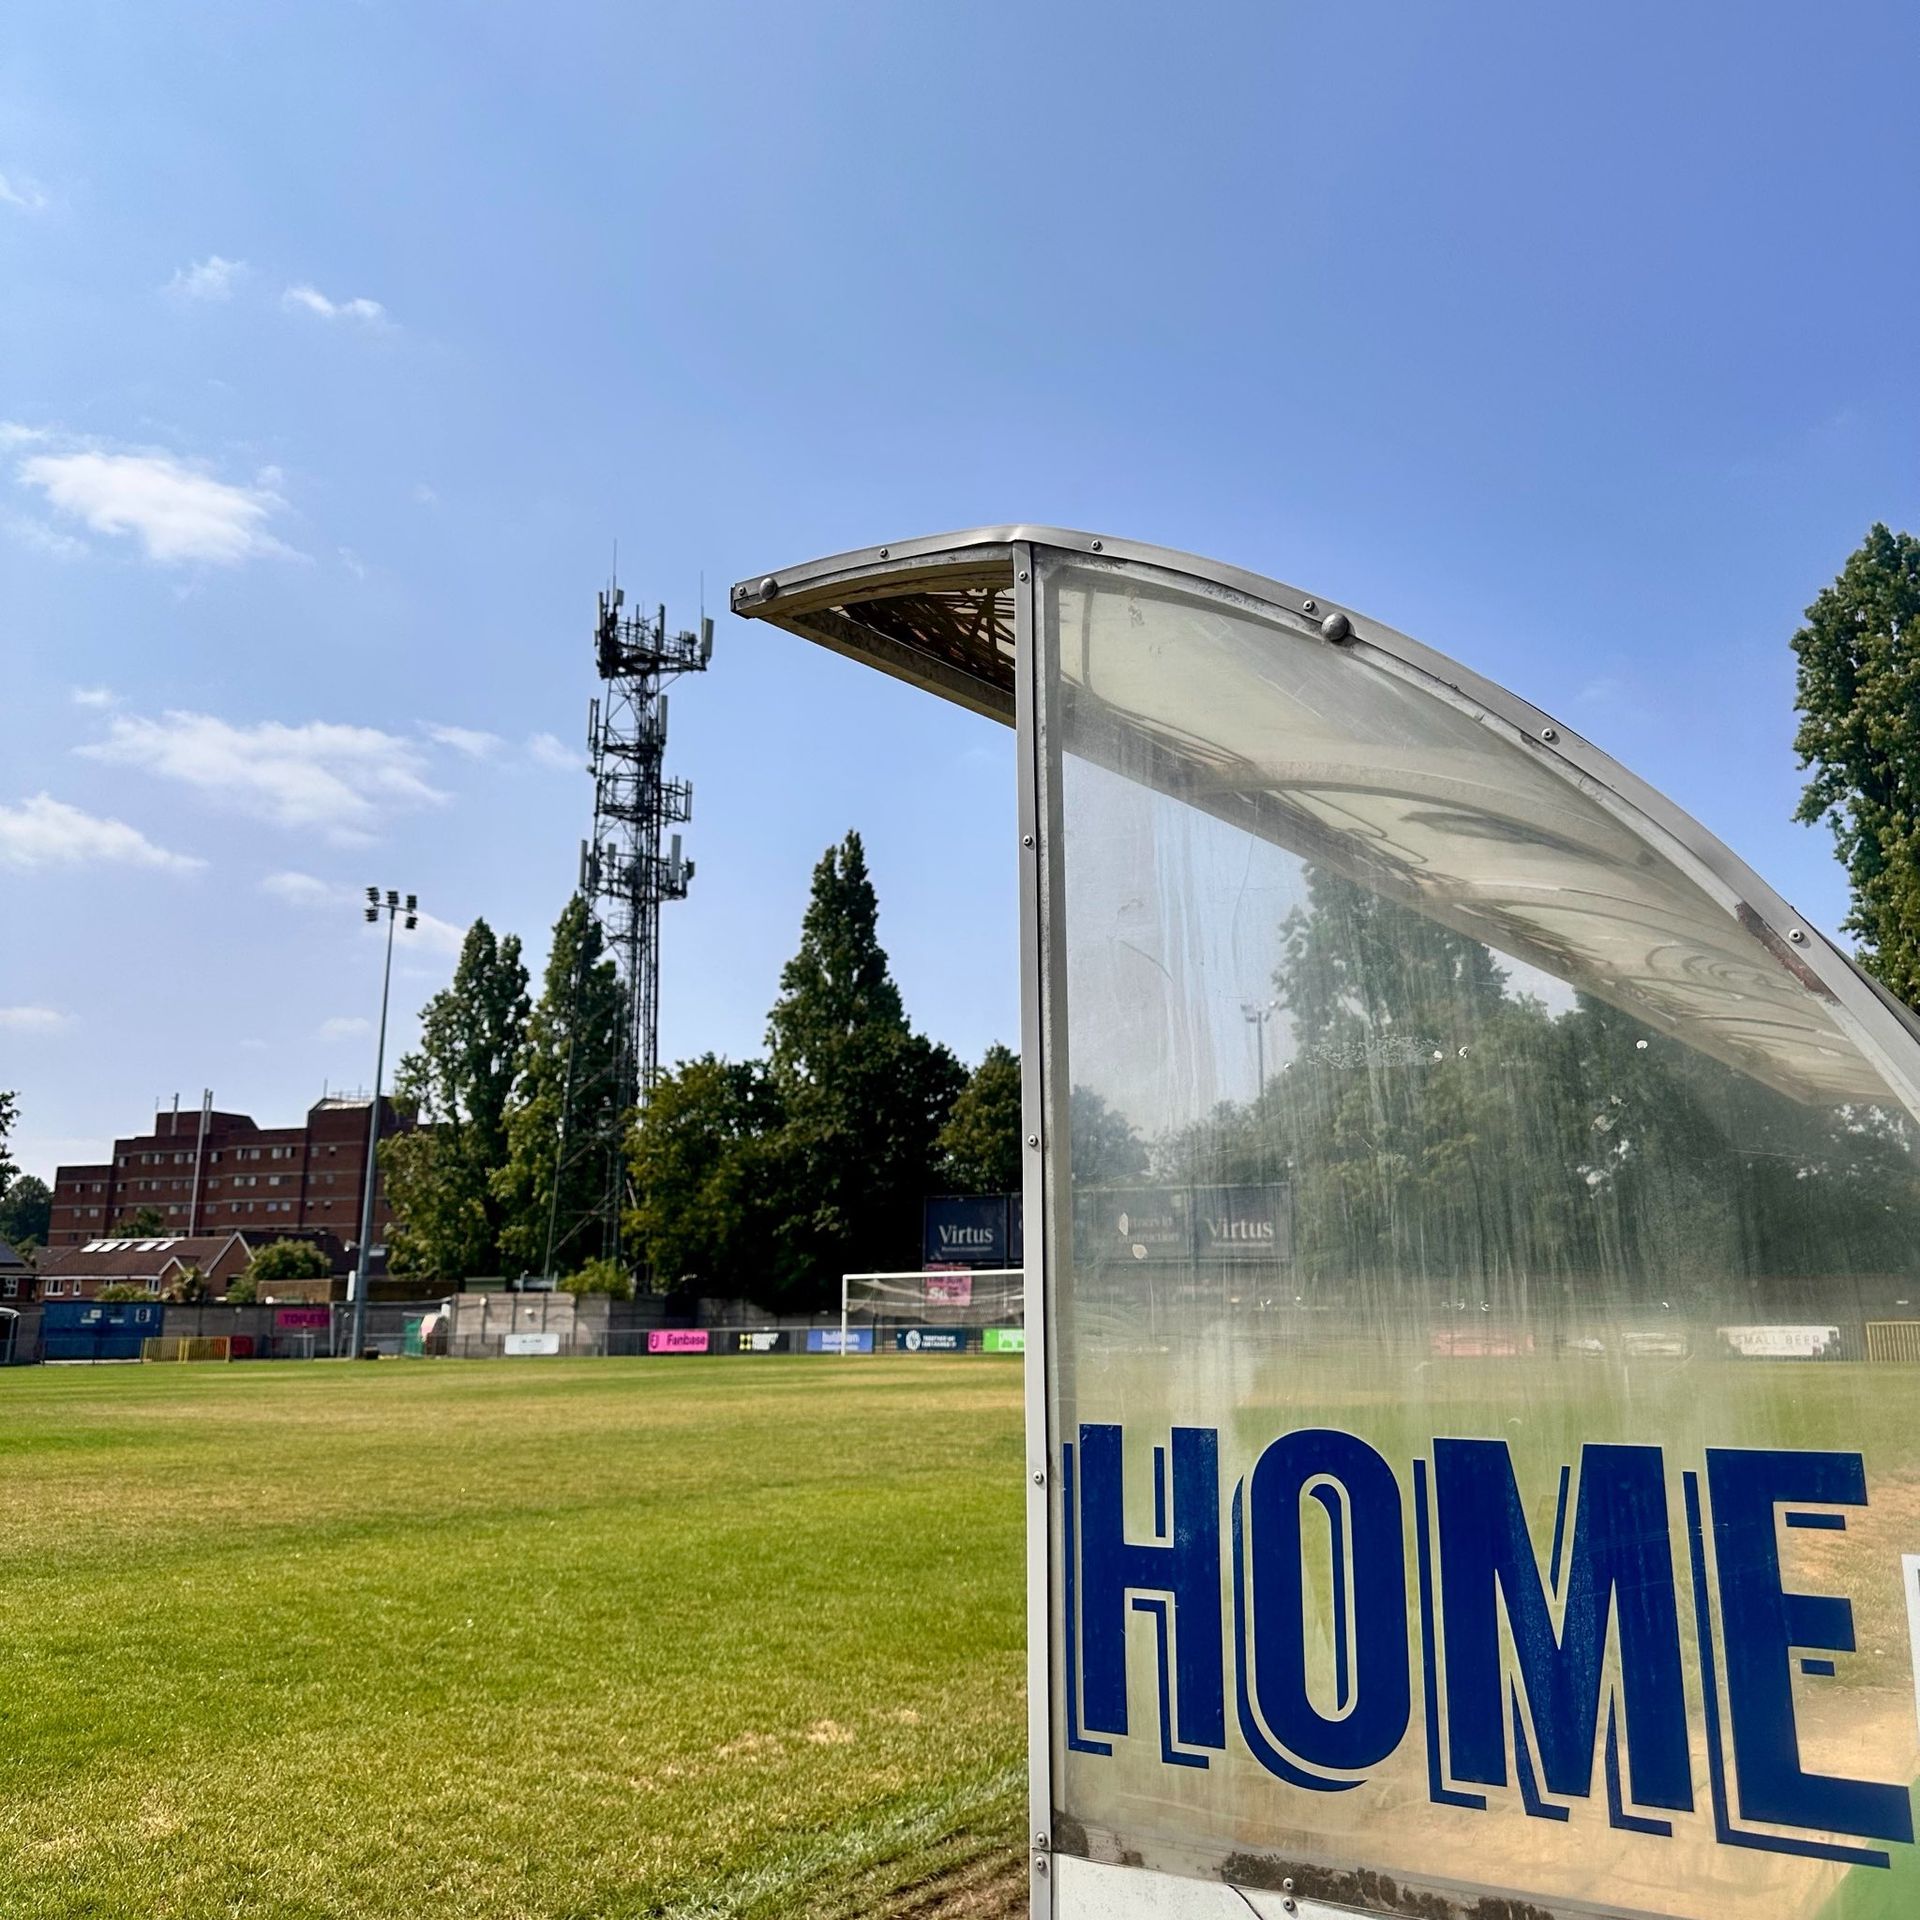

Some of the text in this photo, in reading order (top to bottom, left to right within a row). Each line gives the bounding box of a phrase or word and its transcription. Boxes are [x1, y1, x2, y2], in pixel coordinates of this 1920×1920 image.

[938, 1224, 994, 1244] Virtus
[1202, 1217, 1273, 1239] Virtus
[666, 1333, 706, 1346] Fanbase
[1735, 1334, 1820, 1345] SMALL BEER
[1064, 1423, 1914, 1868] HOME
